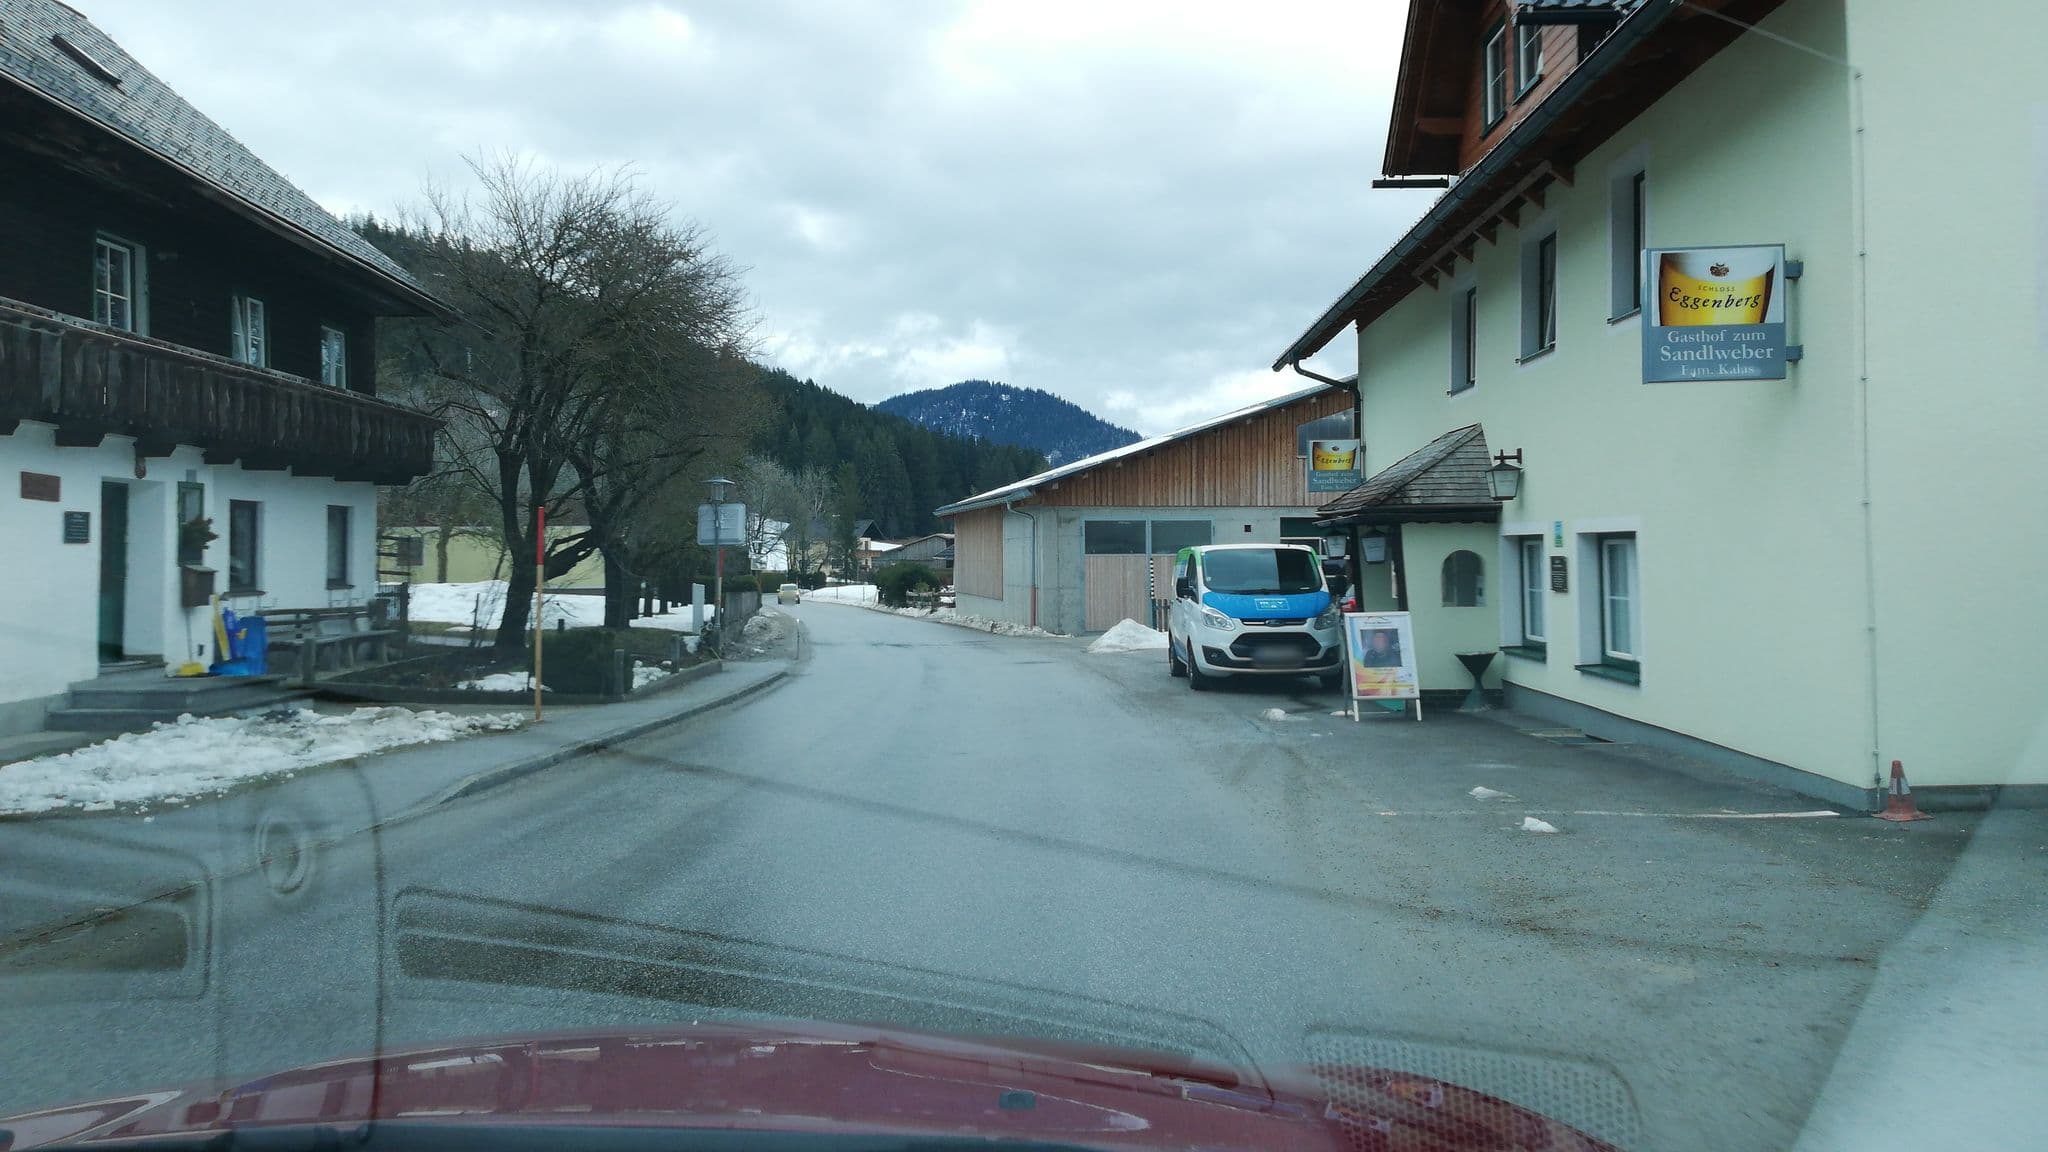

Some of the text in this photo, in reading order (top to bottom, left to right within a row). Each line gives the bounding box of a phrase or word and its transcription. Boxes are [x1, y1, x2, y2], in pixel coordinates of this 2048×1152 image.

[1669, 287, 1761, 309] Eggenberg
[1667, 329, 1766, 343] Gasthof zum
[1660, 344, 1774, 361] Sandlweber
